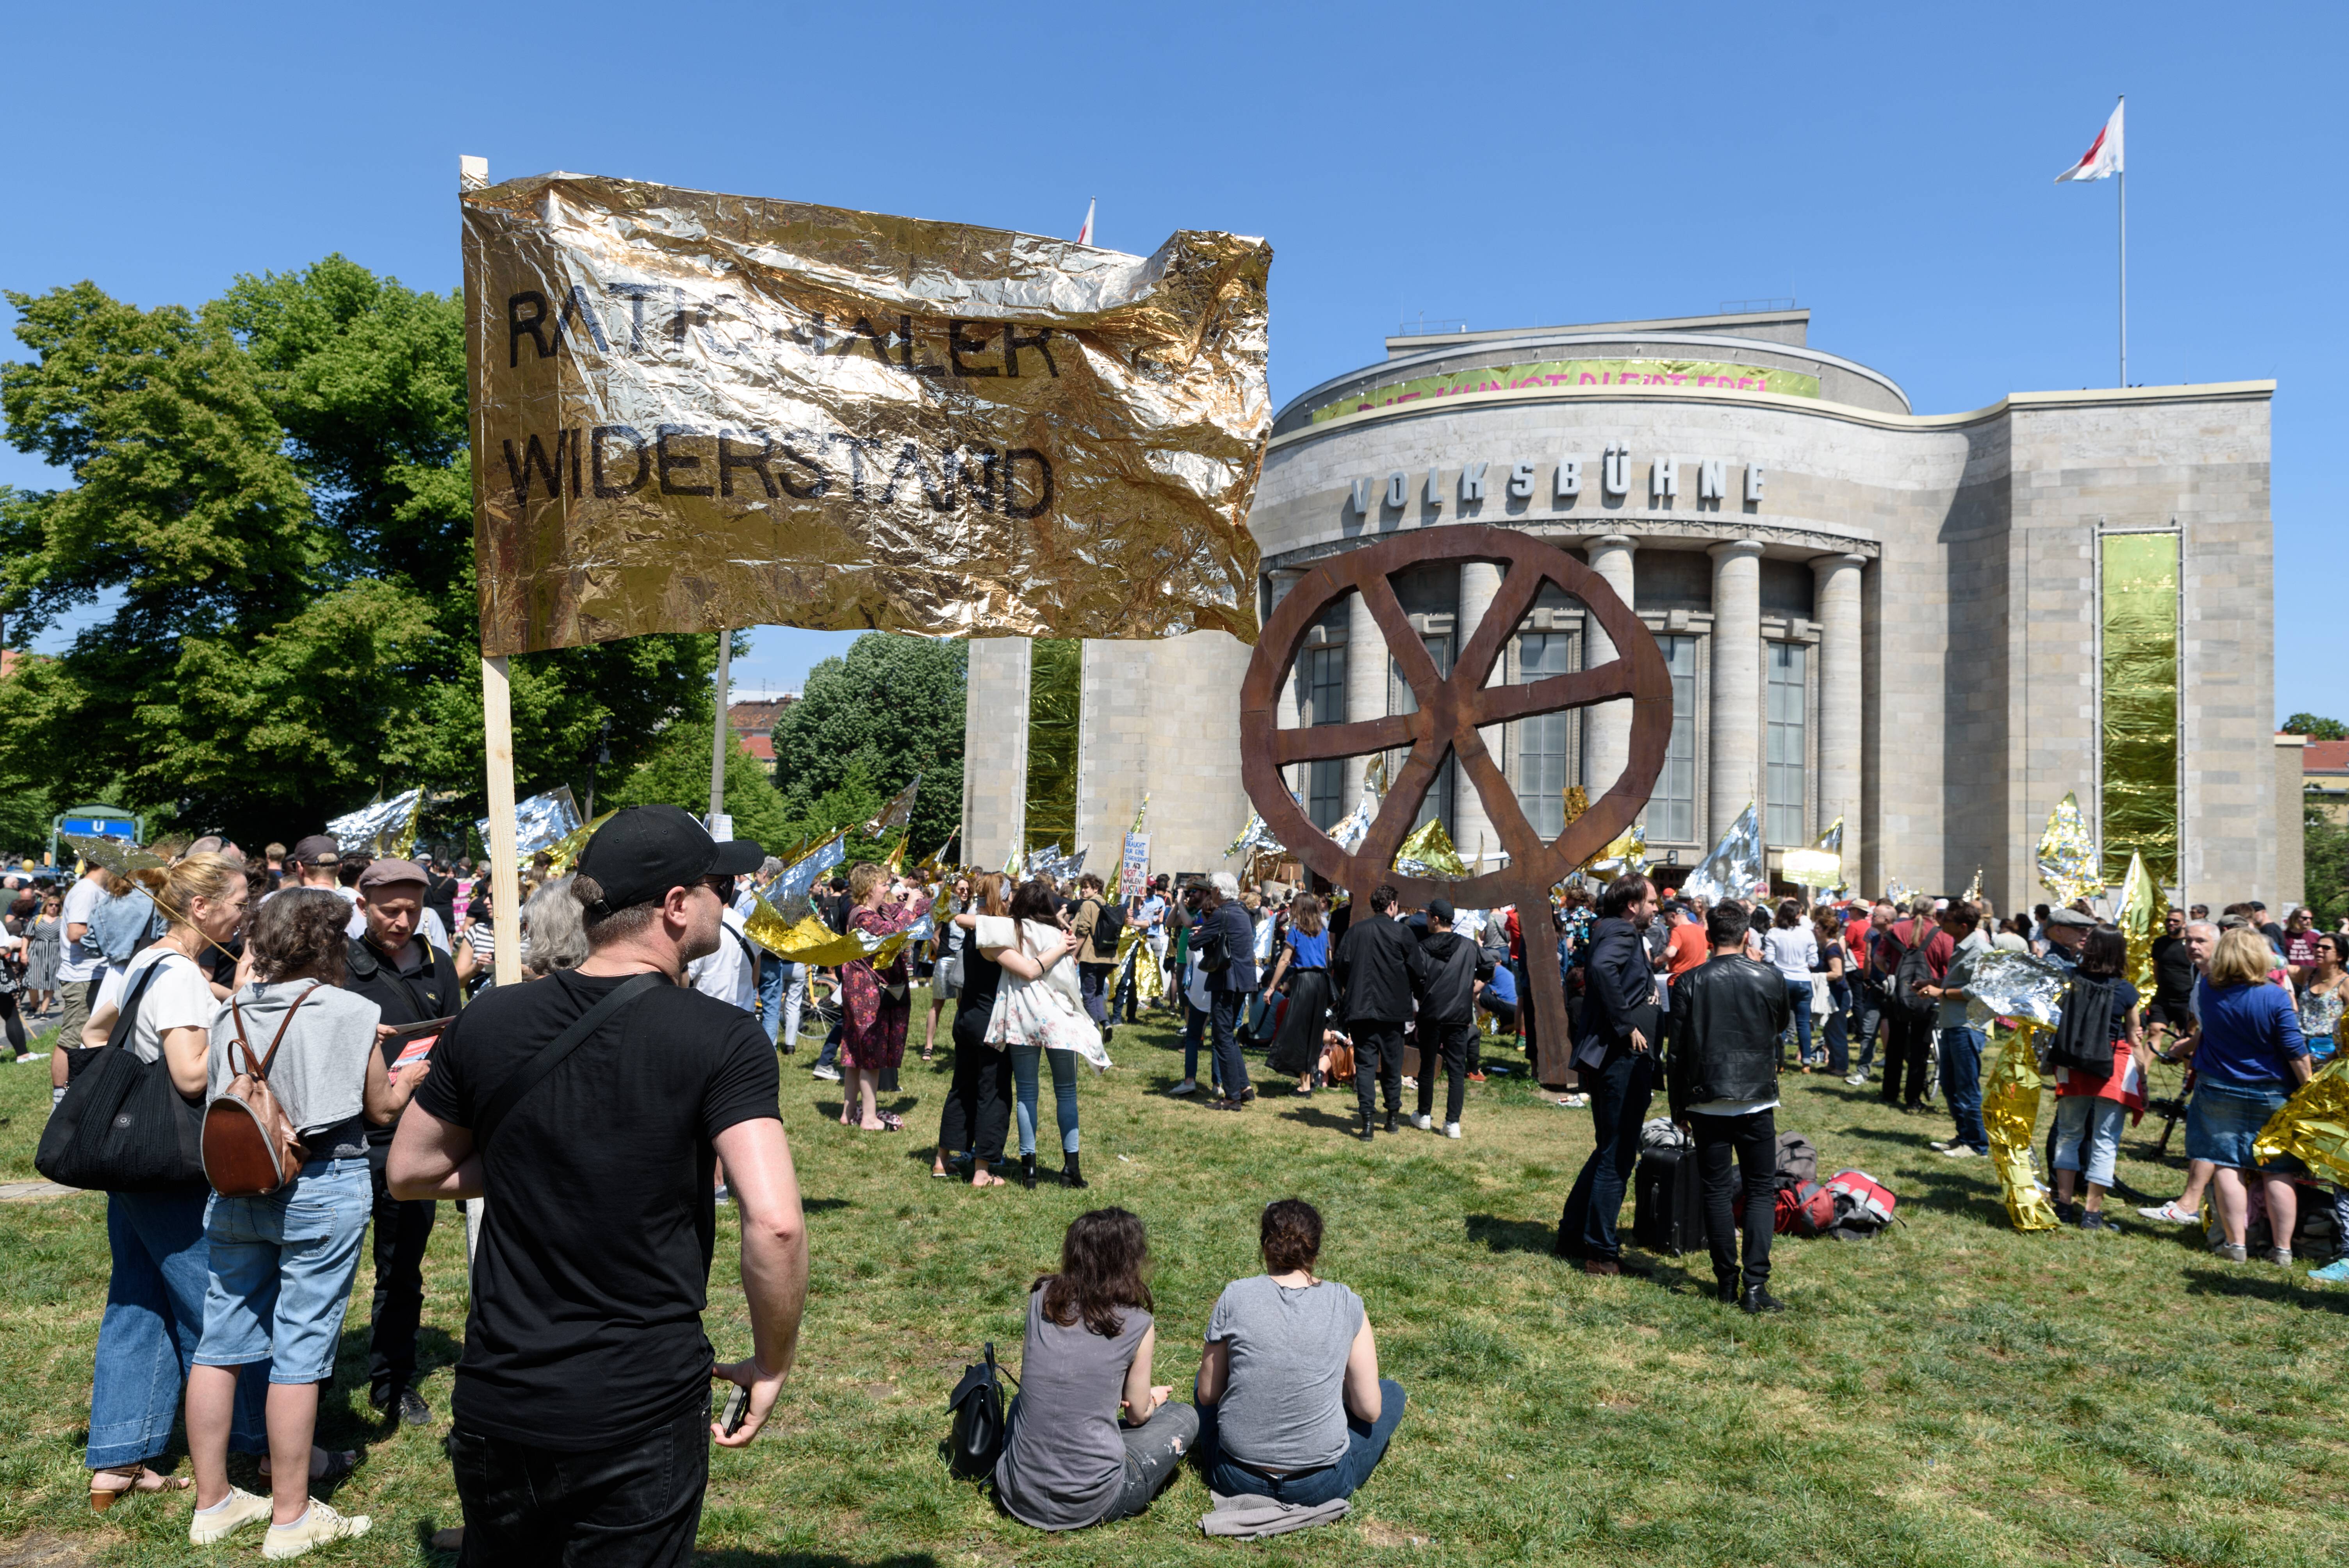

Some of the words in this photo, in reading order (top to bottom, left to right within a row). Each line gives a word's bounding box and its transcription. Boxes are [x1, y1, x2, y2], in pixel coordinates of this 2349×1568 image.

[503, 424, 1053, 519] WIDERSTAND
[1351, 440, 1765, 515] VOLKSBÜHNE
[93, 820, 105, 832] U
[1126, 840, 1146, 849] BRAUCHT
[1124, 868, 1136, 877] NICHT
[1121, 885, 1144, 894] ANSTAND
